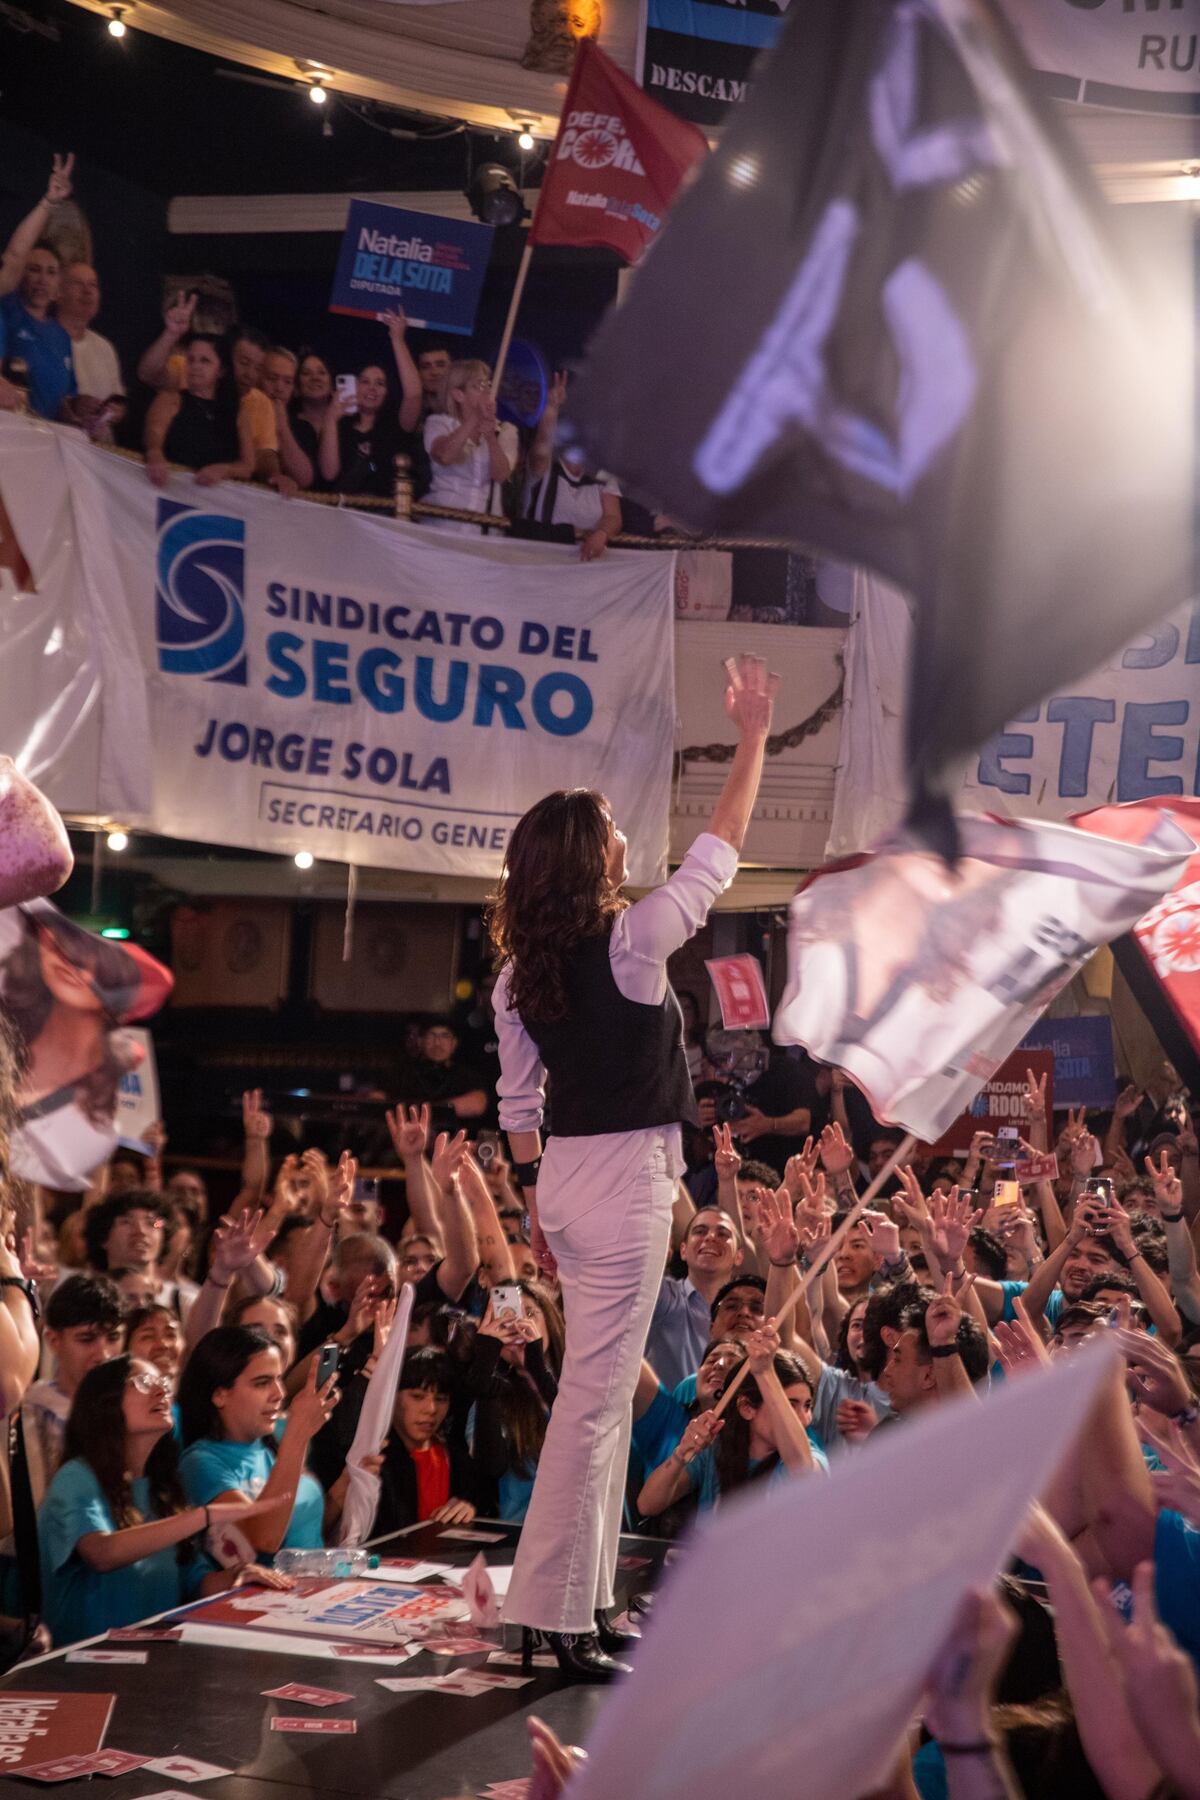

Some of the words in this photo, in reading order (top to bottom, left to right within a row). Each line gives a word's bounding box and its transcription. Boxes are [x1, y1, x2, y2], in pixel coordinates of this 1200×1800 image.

[1138, 34, 1200, 72] RU
[565, 111, 626, 134] DEFE
[357, 227, 432, 263] Natalia
[265, 582, 504, 650] SINDICATO
[518, 621, 598, 662] DEL
[264, 631, 593, 737] SEGURO
[196, 719, 333, 775] JORGE
[341, 742, 450, 794] SOLA
[977, 696, 1200, 802] ETE
[268, 799, 423, 841] SECRETARIO
[431, 822, 514, 850] GENE
[0, 1698, 59, 1743] Natalia
